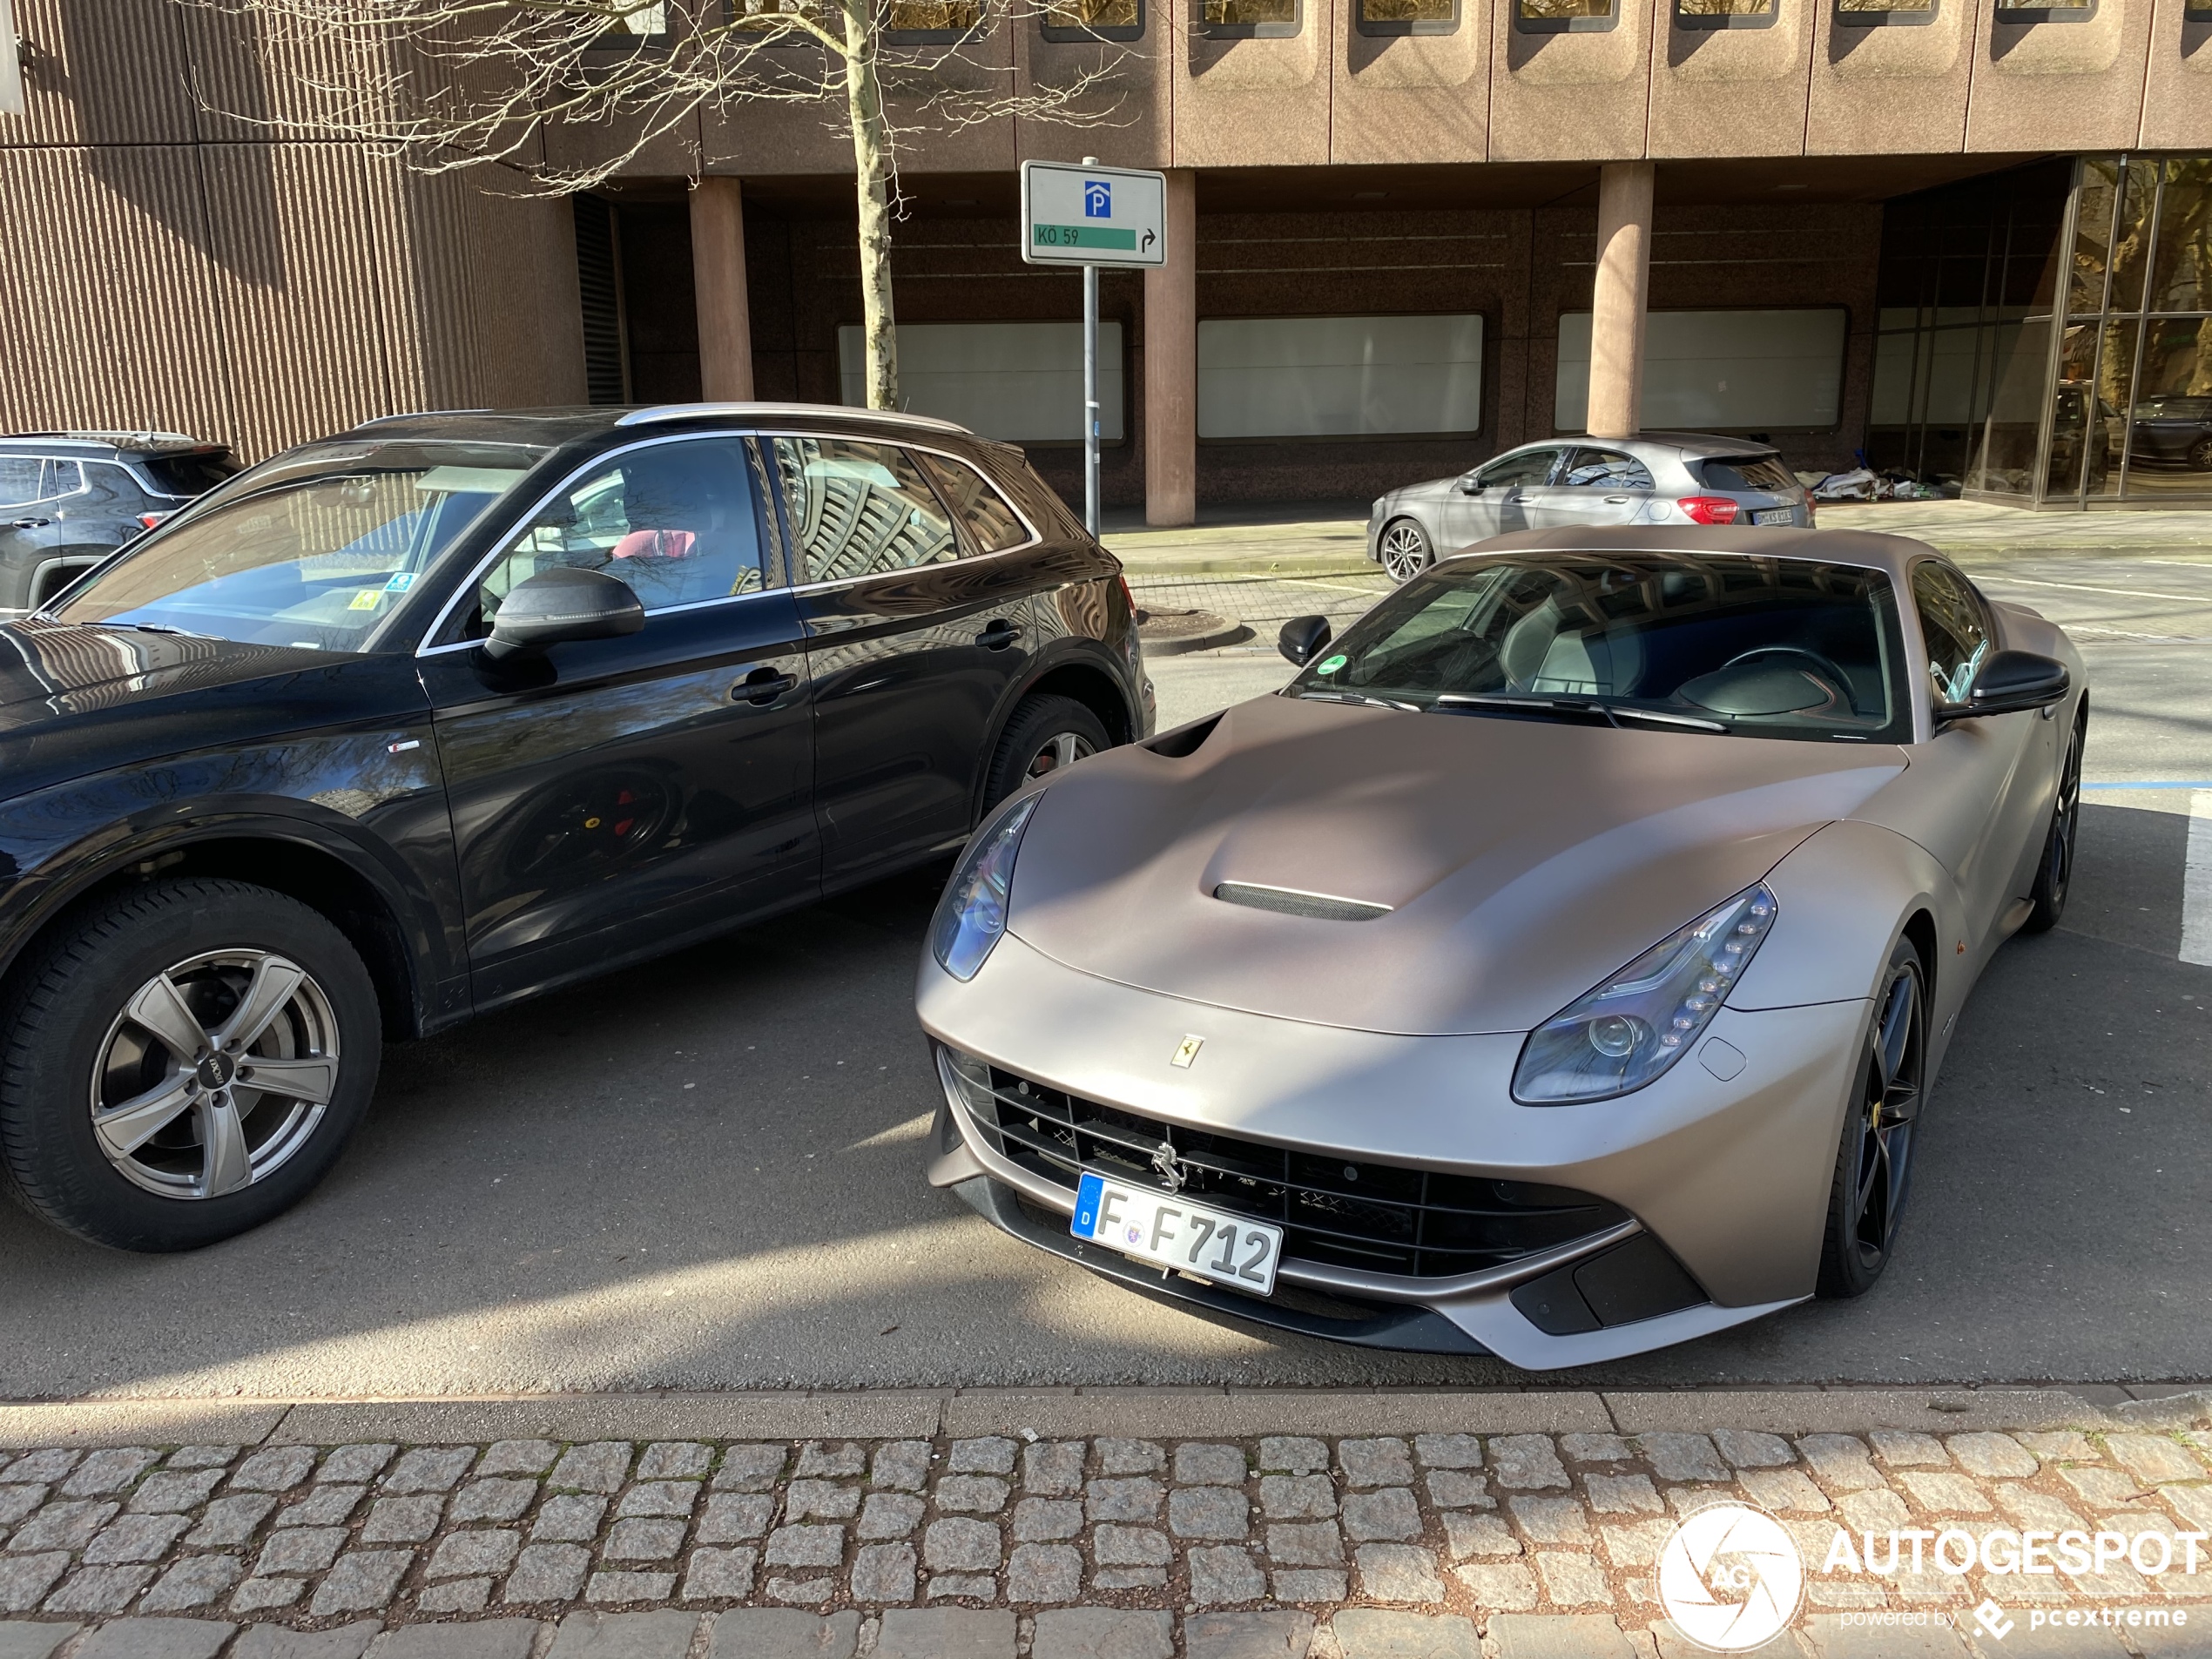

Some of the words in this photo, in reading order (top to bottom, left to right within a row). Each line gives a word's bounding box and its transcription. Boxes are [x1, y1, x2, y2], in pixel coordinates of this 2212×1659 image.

[1038, 225, 1056, 244] KÖ
[1063, 228, 1078, 245] 59
[1777, 510, 1792, 522] 8183
[1081, 1211, 1090, 1225] D
